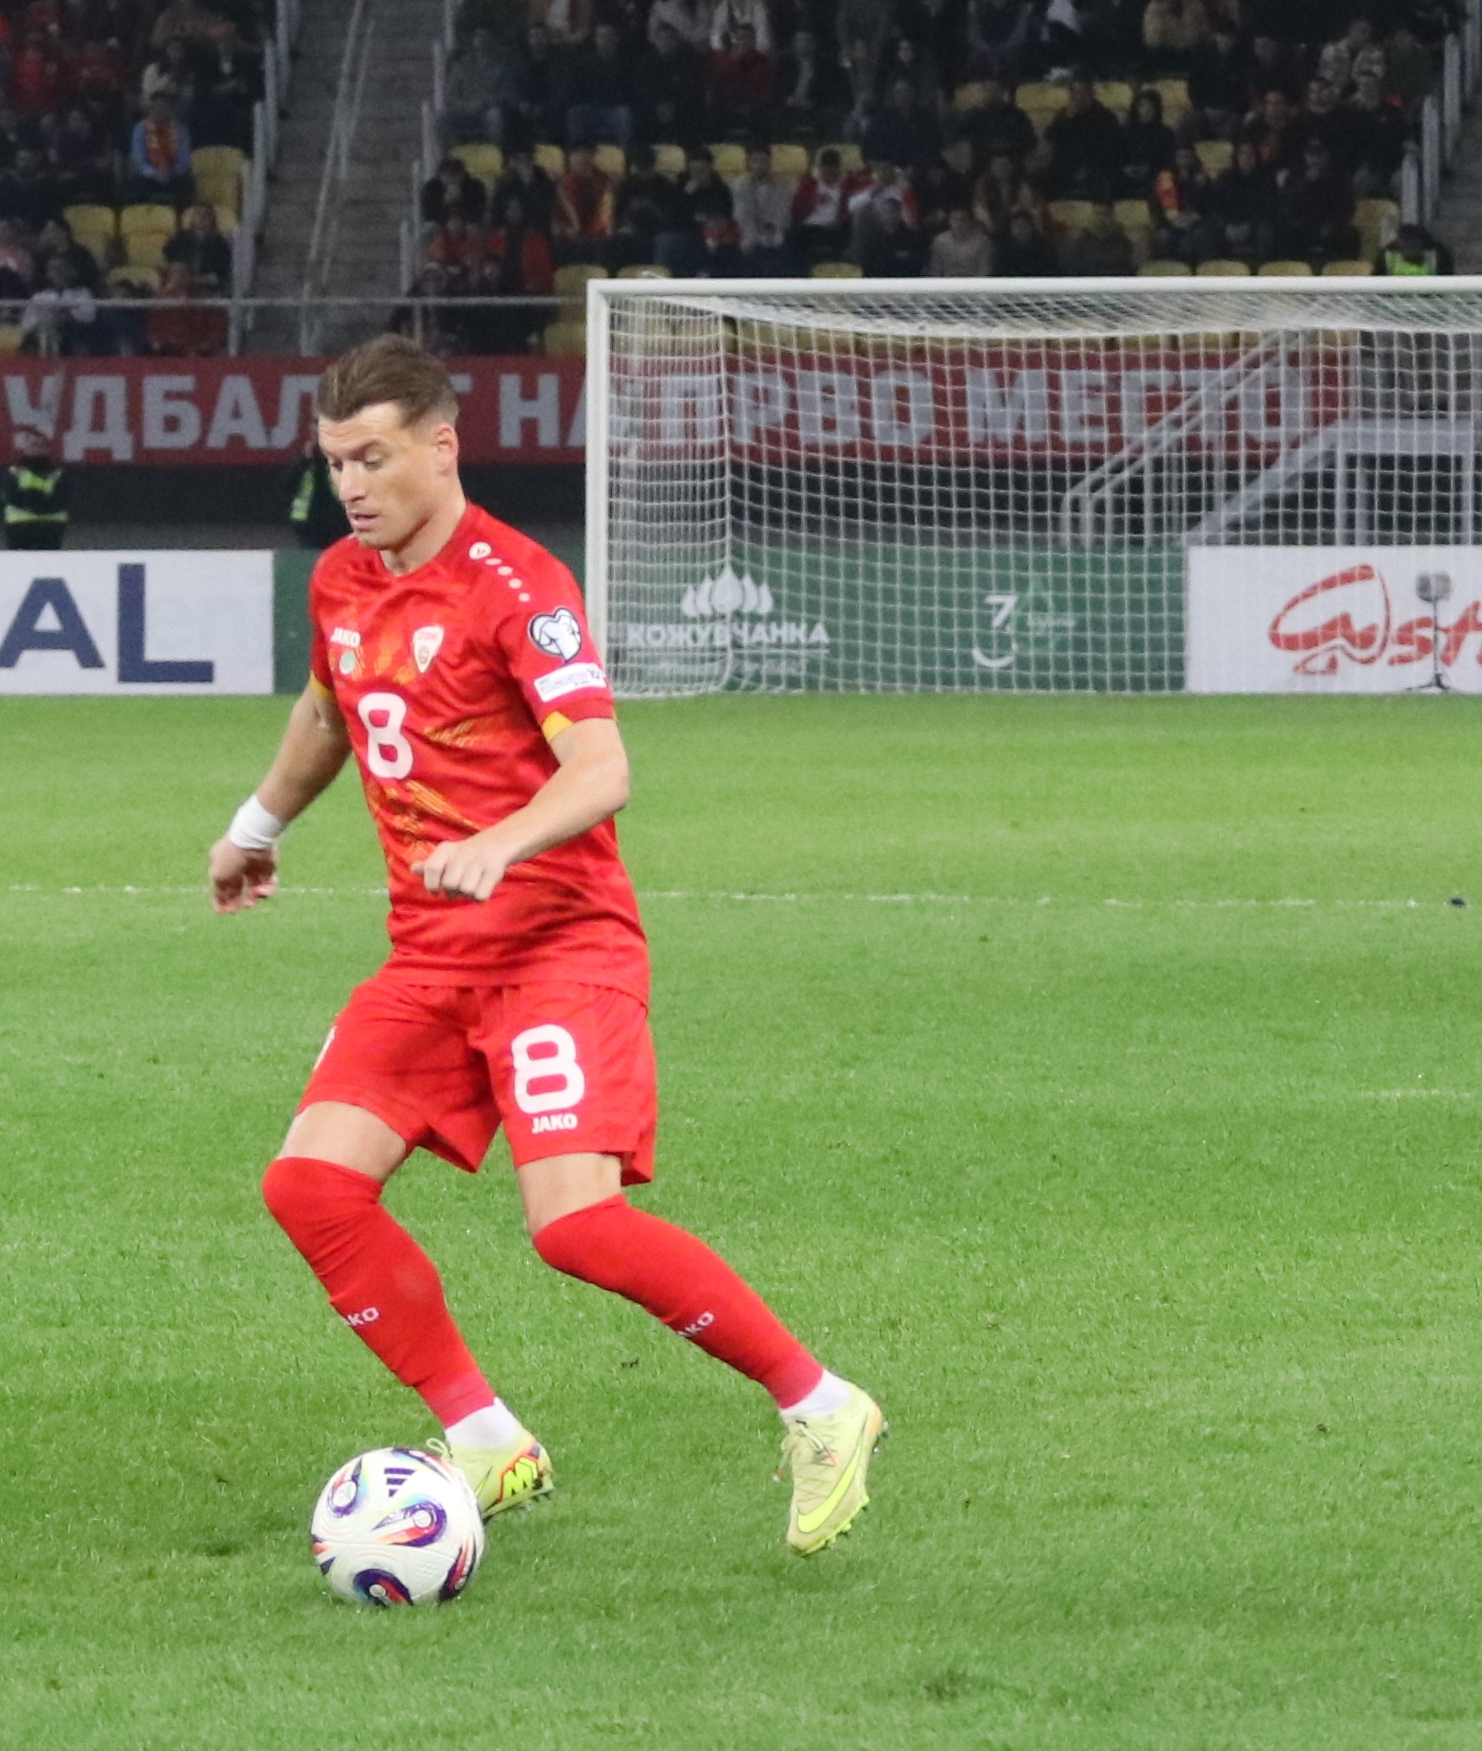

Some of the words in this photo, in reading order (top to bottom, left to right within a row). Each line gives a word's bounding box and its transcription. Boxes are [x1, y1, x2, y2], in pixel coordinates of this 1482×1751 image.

[661, 370, 932, 446] ПРВО
[967, 367, 1312, 444] МЕСТО
[357, 692, 415, 780] 8
[511, 1024, 586, 1114] 8
[531, 1113, 579, 1134] JAKO
